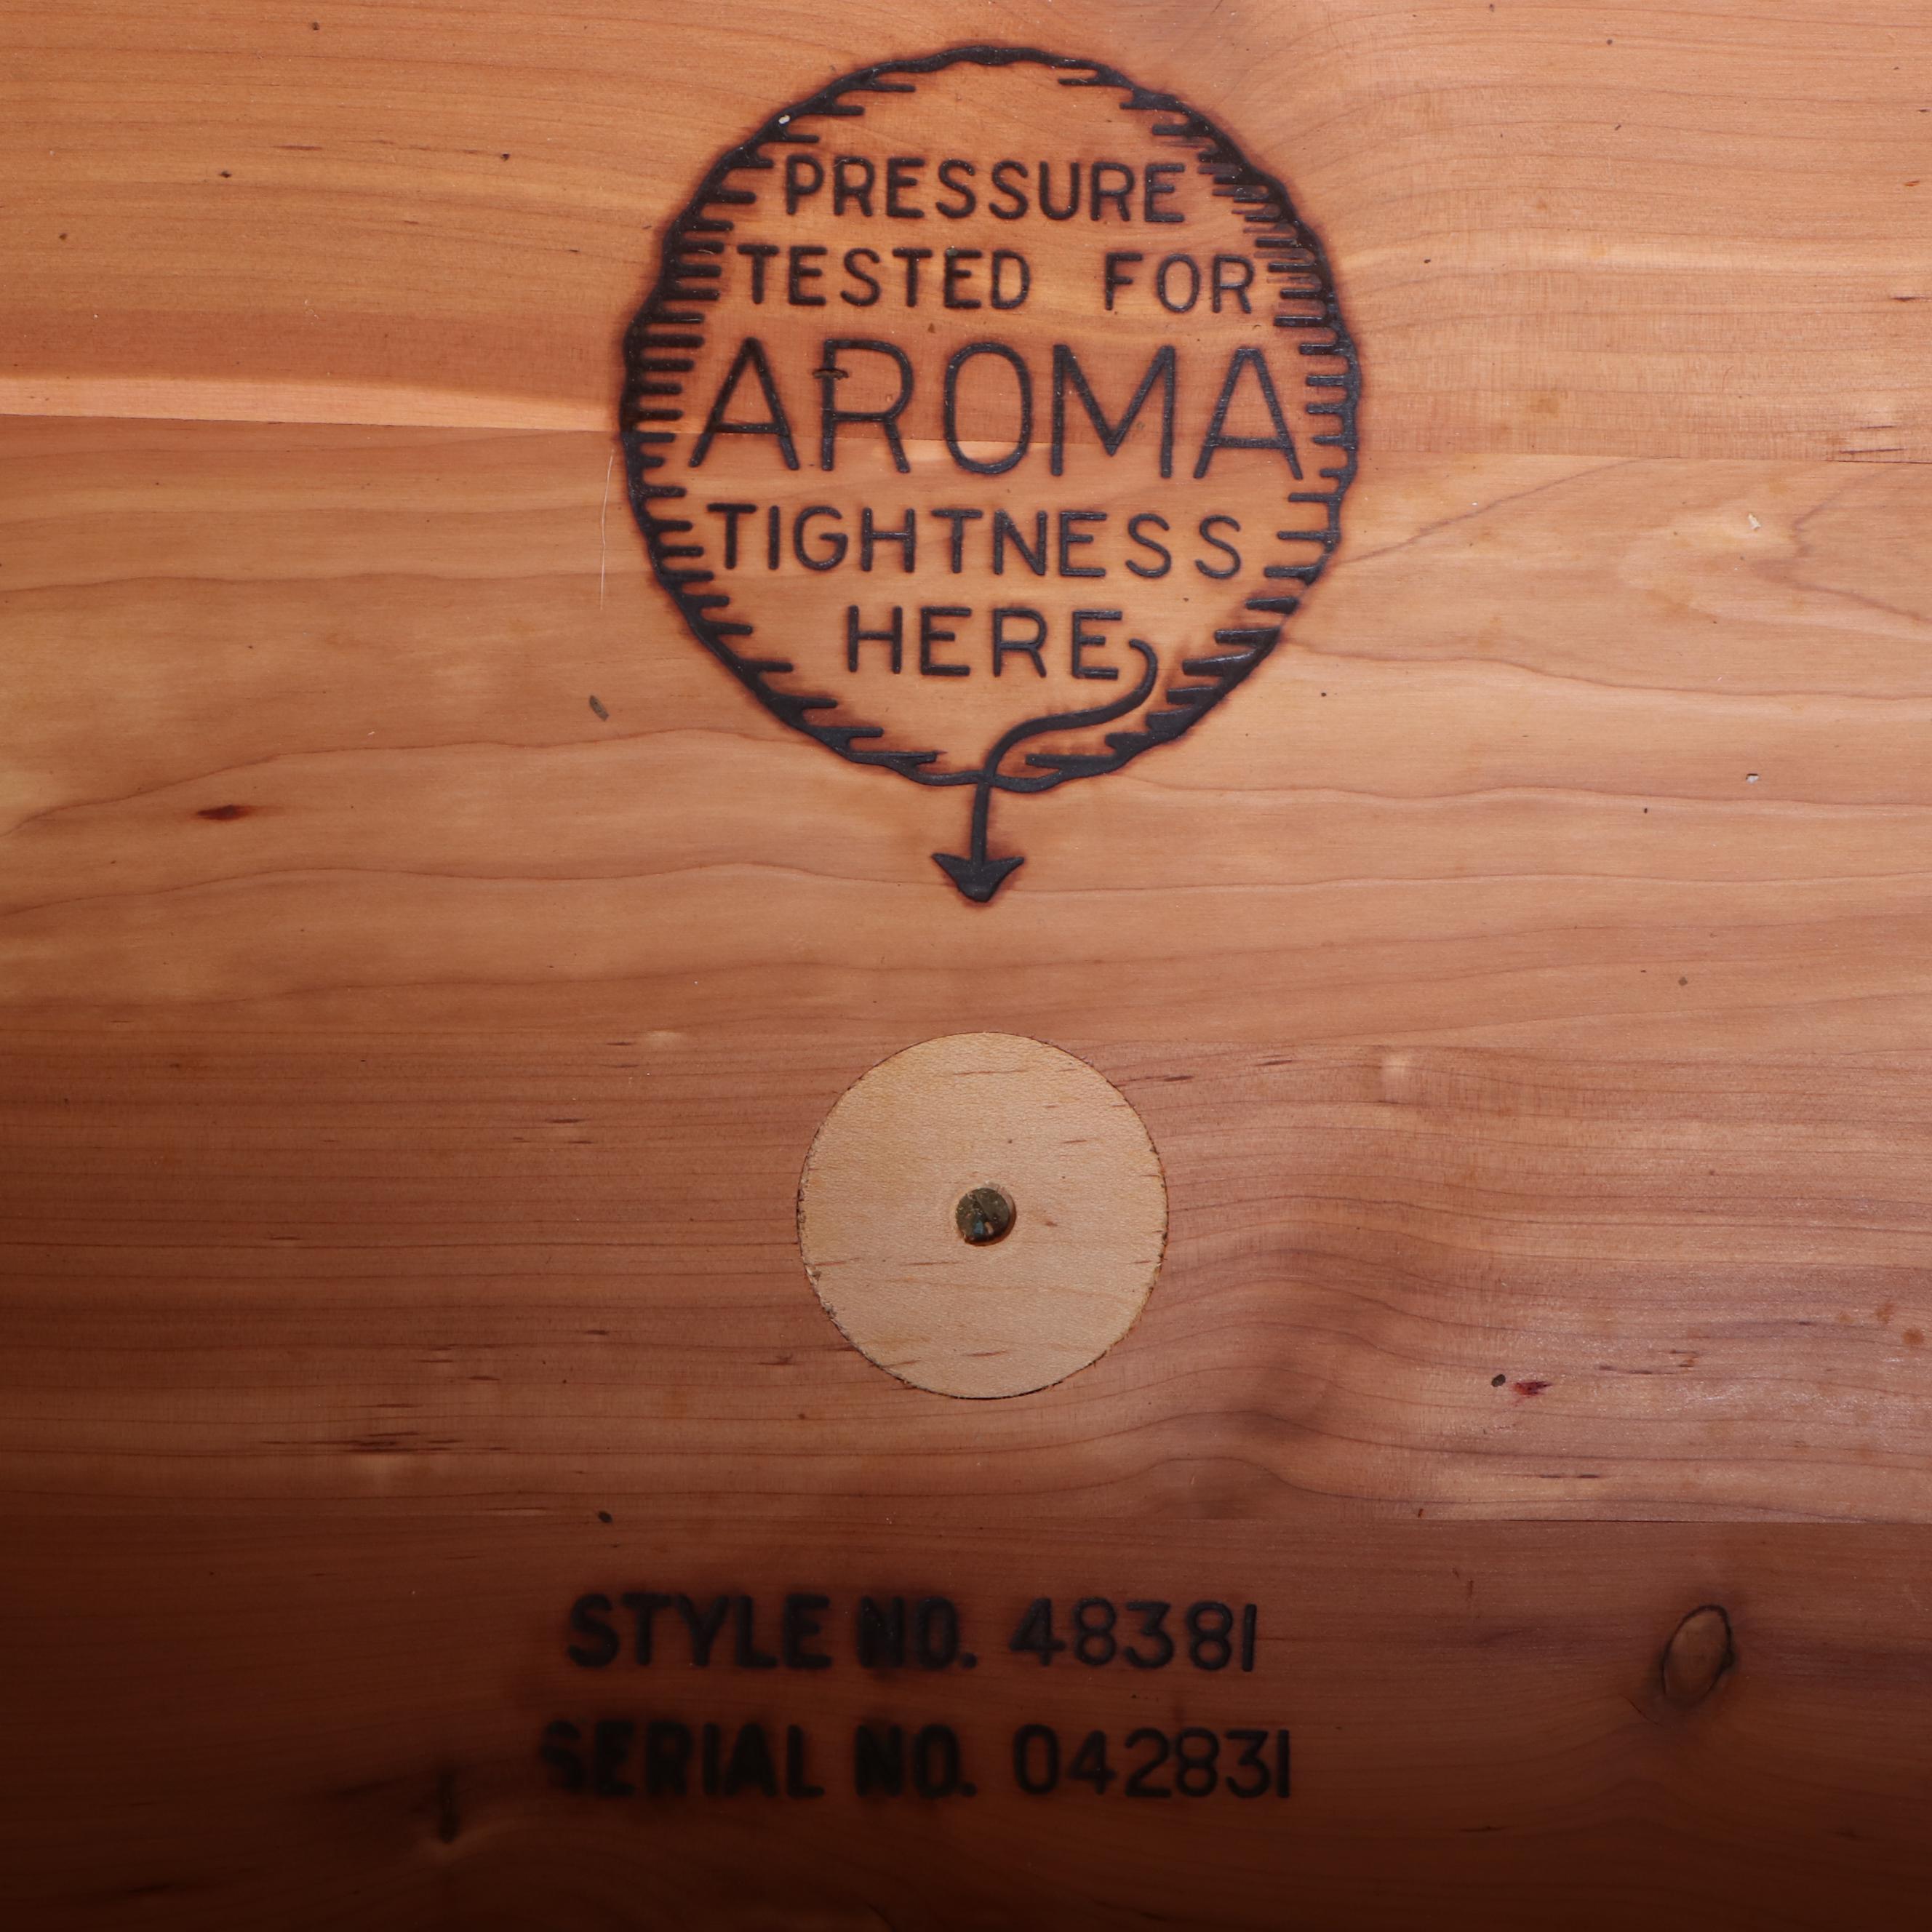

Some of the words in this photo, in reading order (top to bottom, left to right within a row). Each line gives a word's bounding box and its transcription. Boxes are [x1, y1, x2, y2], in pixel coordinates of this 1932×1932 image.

[783, 153, 1186, 223] PRESSURE
[737, 244, 1031, 309] TESTED
[1103, 252, 1256, 314] FOR
[688, 337, 1304, 479] AROMA
[707, 503, 1242, 579] TIGHTNESS
[847, 604, 1122, 679] HERE
[567, 1592, 833, 1669] STYLE
[856, 1595, 978, 1670] NO.
[1008, 1596, 1258, 1672] 48381
[540, 1720, 825, 1798] SERIAL
[854, 1723, 978, 1800] NO.
[1013, 1723, 1290, 1798] 042831
